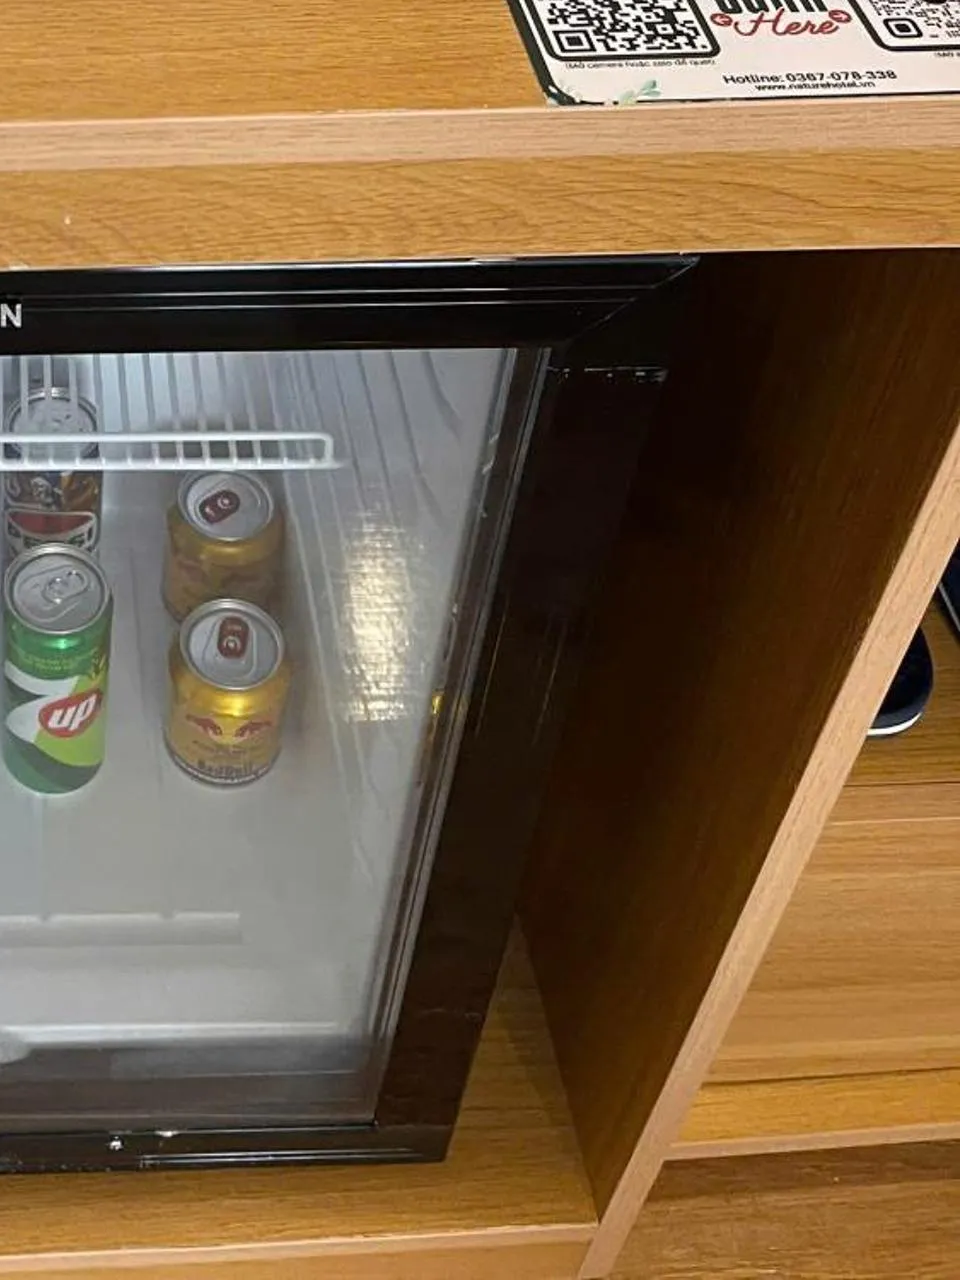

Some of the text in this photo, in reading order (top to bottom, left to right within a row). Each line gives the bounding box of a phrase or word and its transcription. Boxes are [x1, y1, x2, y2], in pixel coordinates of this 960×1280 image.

[733, 7, 841, 37] Here
[722, 70, 898, 85] Hotline: 0367-078-338
